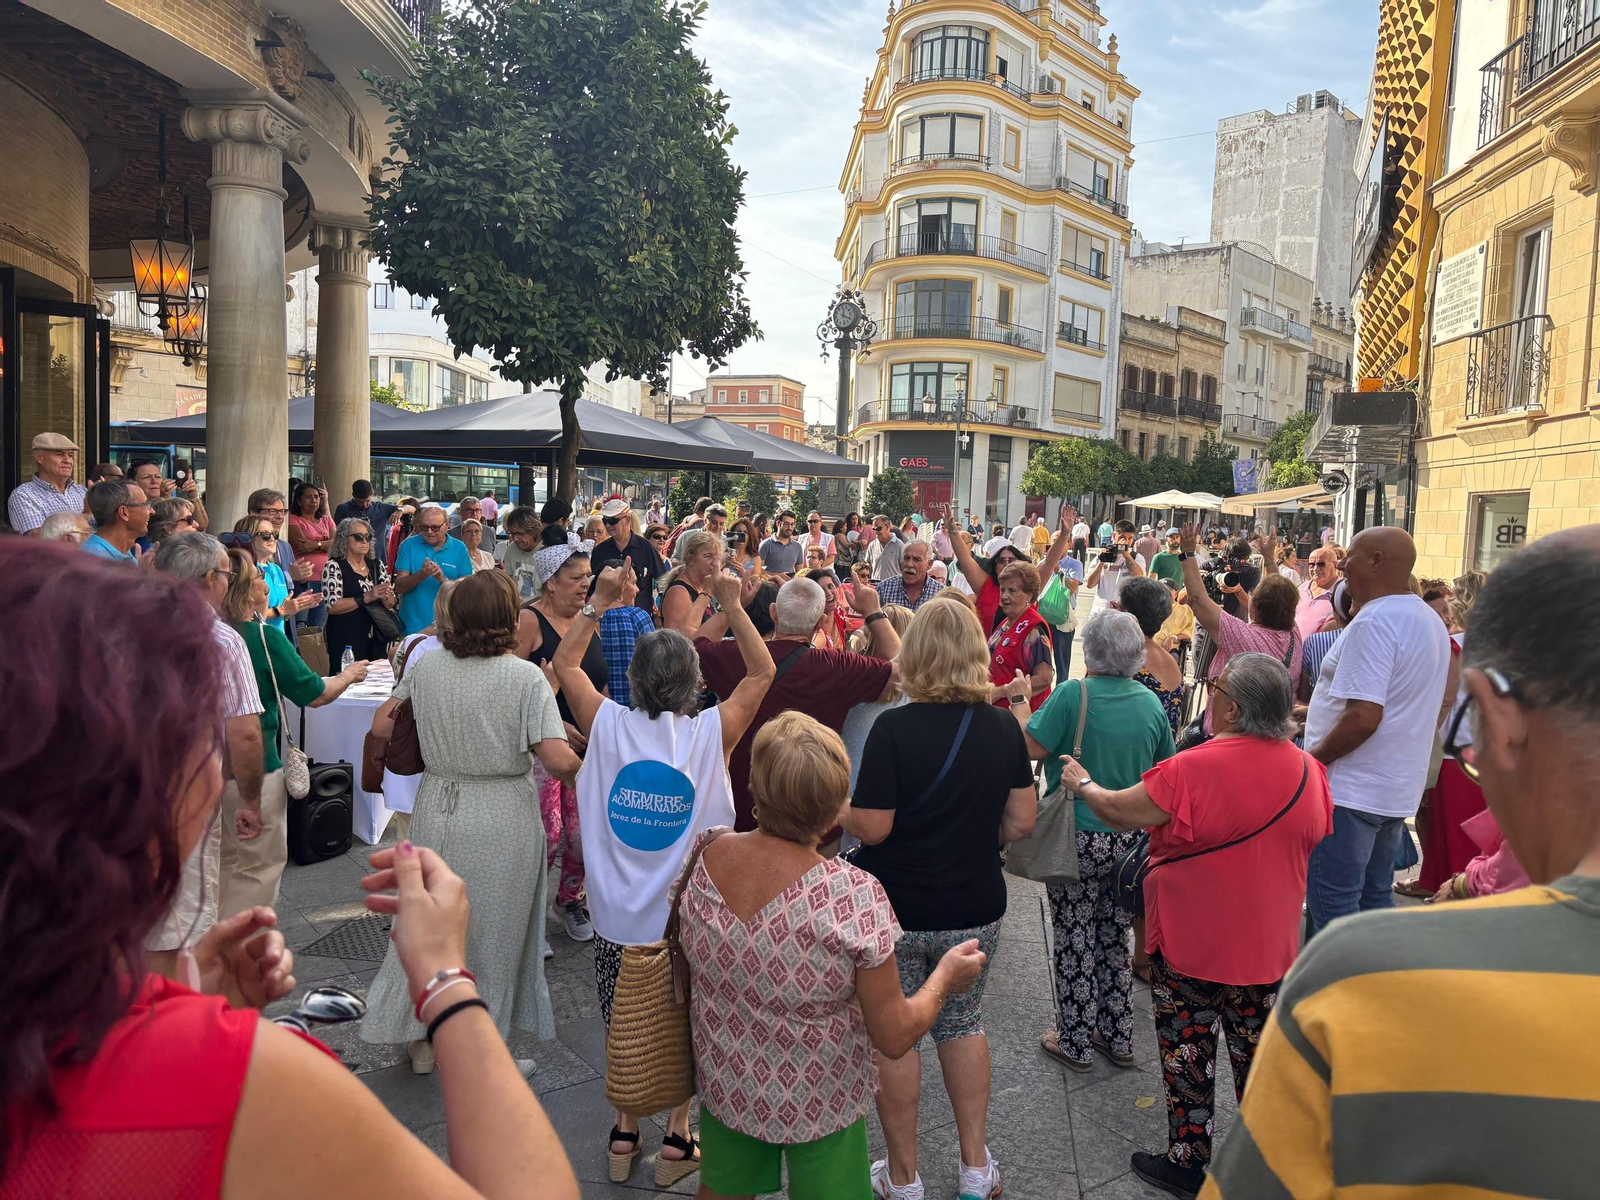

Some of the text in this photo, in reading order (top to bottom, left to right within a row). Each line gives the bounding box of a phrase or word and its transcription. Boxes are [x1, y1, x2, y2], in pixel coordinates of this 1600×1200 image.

[899, 457, 929, 468] GAES
[928, 501, 946, 509] GAE
[610, 810, 687, 827] Jerez de la Frontera
